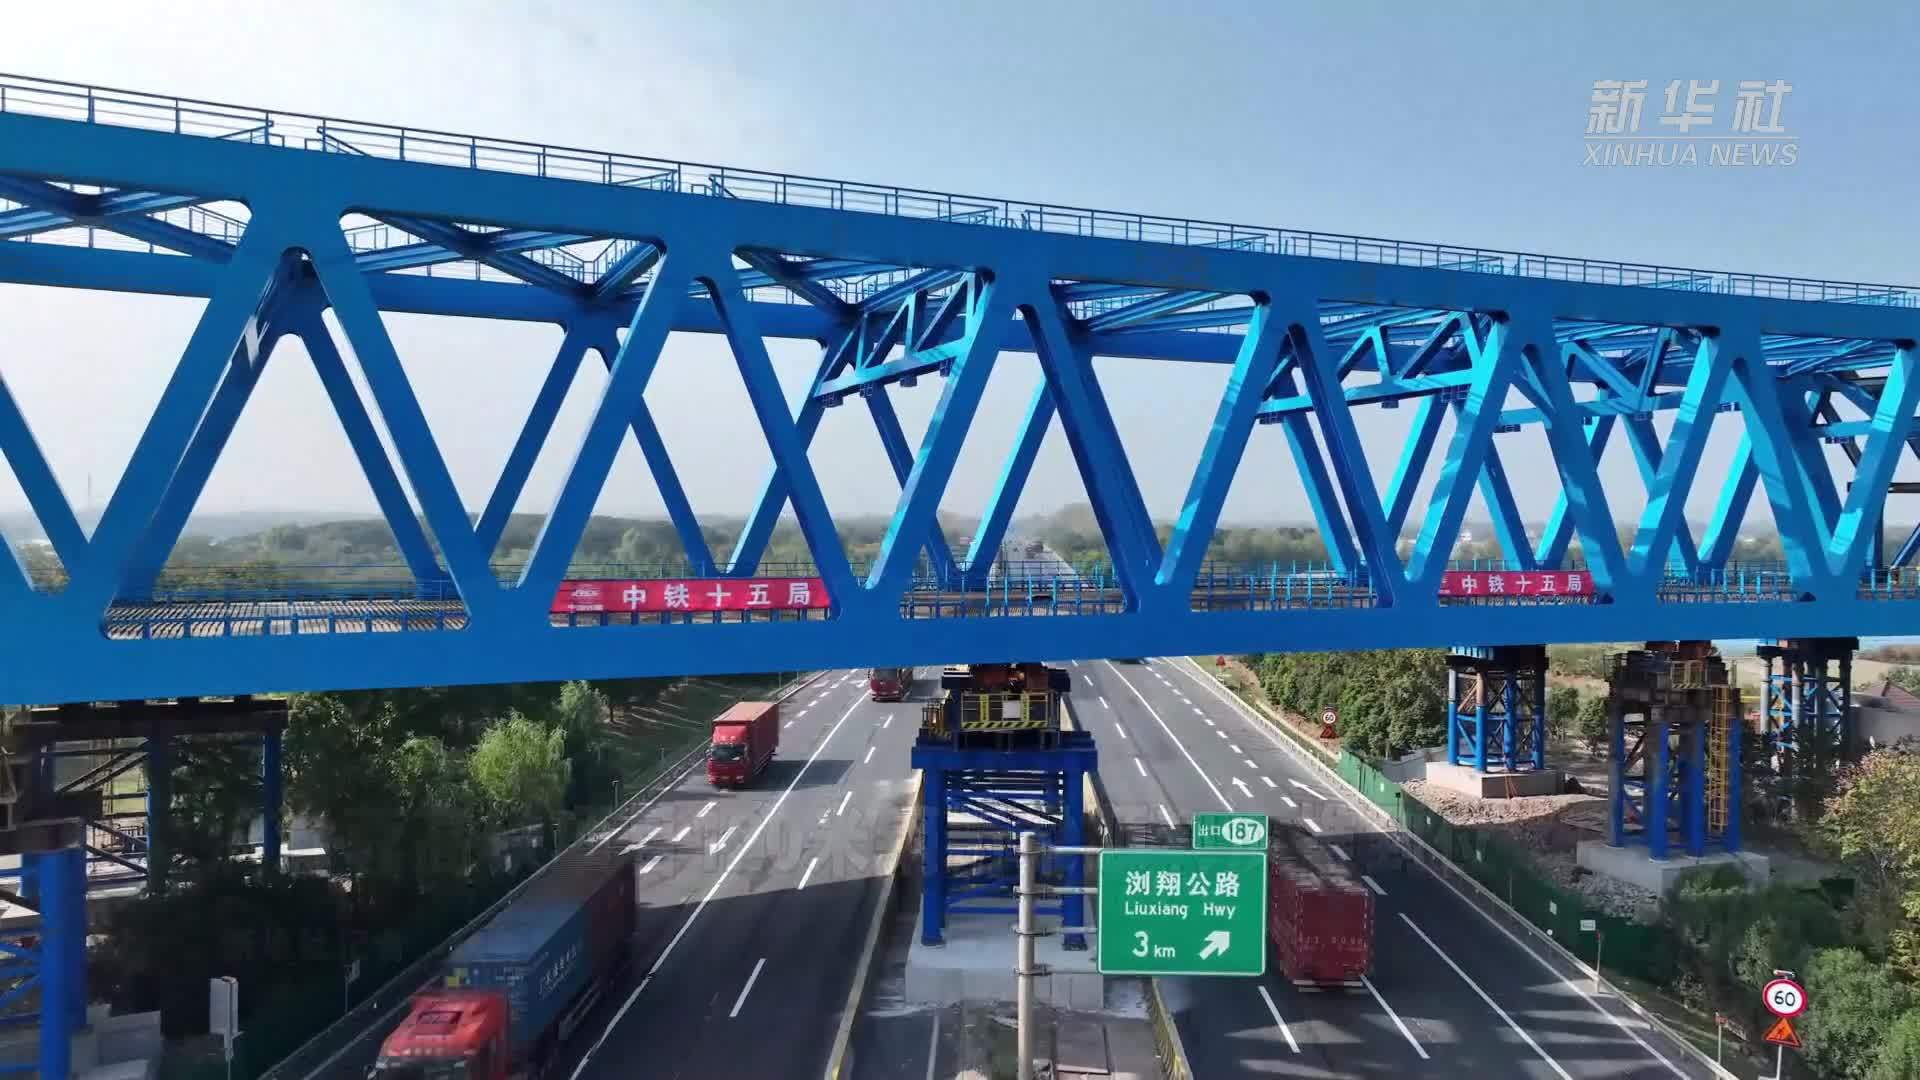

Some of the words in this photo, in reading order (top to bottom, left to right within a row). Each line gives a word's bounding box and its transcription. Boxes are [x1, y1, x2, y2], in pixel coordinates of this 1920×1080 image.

[1461, 574, 1583, 594] 中铁十五局
[622, 582, 811, 610] 中铁十五局
[1198, 823, 1222, 837] 出口
[1227, 822, 1259, 841] 187
[1127, 871, 1240, 897] 浏翔公路
[1124, 901, 1189, 919] Liuxiang
[1203, 902, 1236, 919] Hwy
[1132, 930, 1149, 958] 3
[1153, 944, 1176, 959] km
[1774, 990, 1796, 1007] 60
